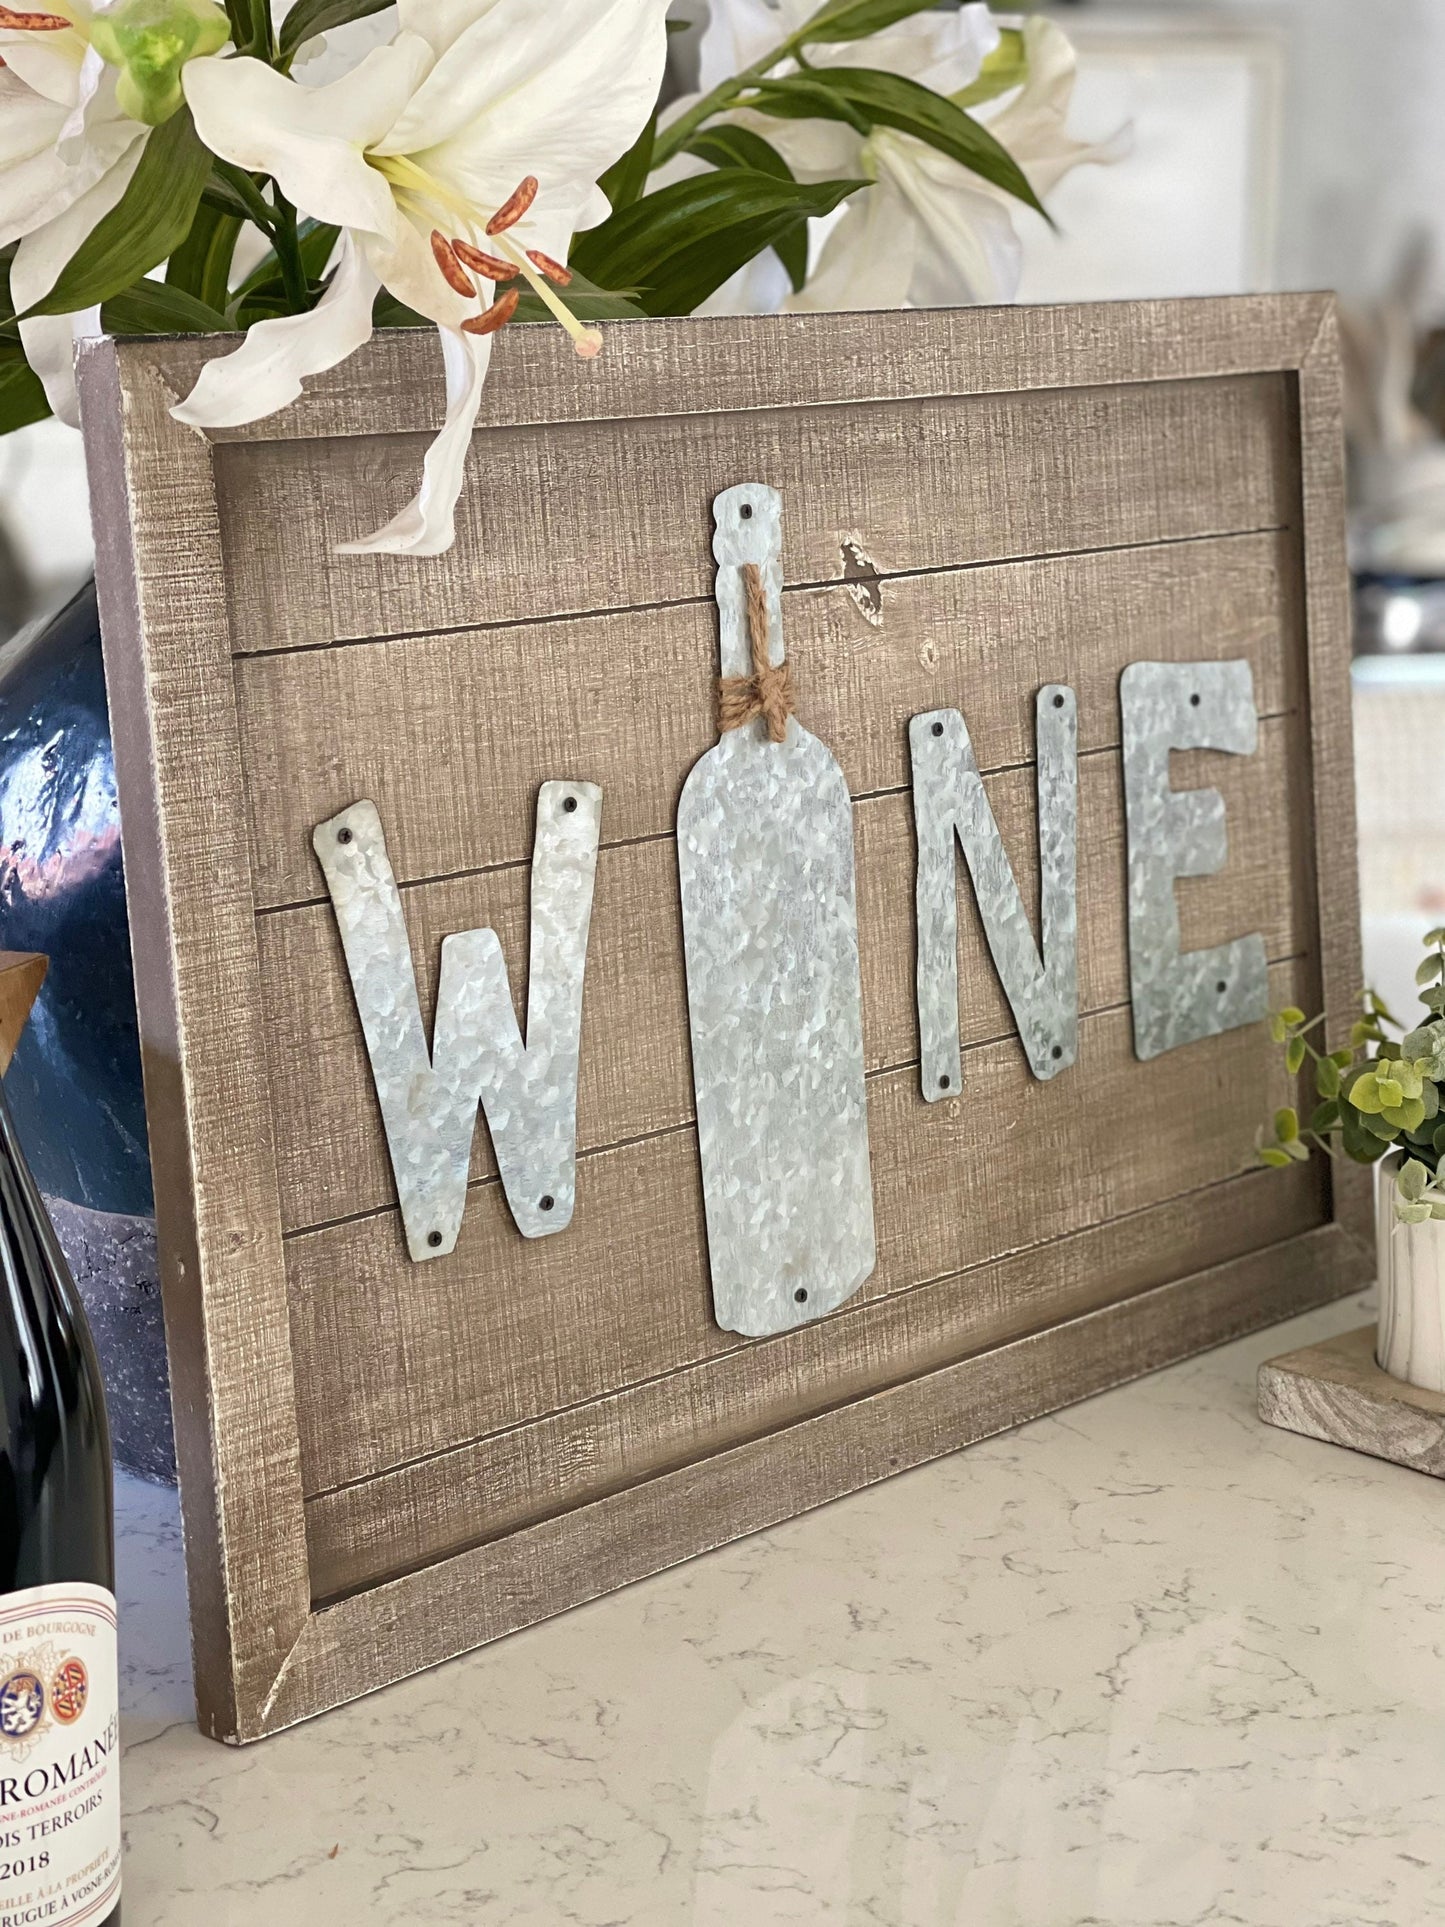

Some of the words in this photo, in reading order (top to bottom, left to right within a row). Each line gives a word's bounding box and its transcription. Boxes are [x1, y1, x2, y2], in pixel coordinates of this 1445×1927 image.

[312, 483, 1270, 1337] WINE
[3, 1629, 23, 1644] DE
[26, 1621, 97, 1637] BOURGOGNE
[0, 1794, 68, 1823] NE-ROMANÉE
[26, 1788, 103, 1841] TERROIRS
[0, 1850, 50, 1880] 2018
[47, 1881, 62, 1896] LA
[2, 1900, 57, 1927] RUGUE
